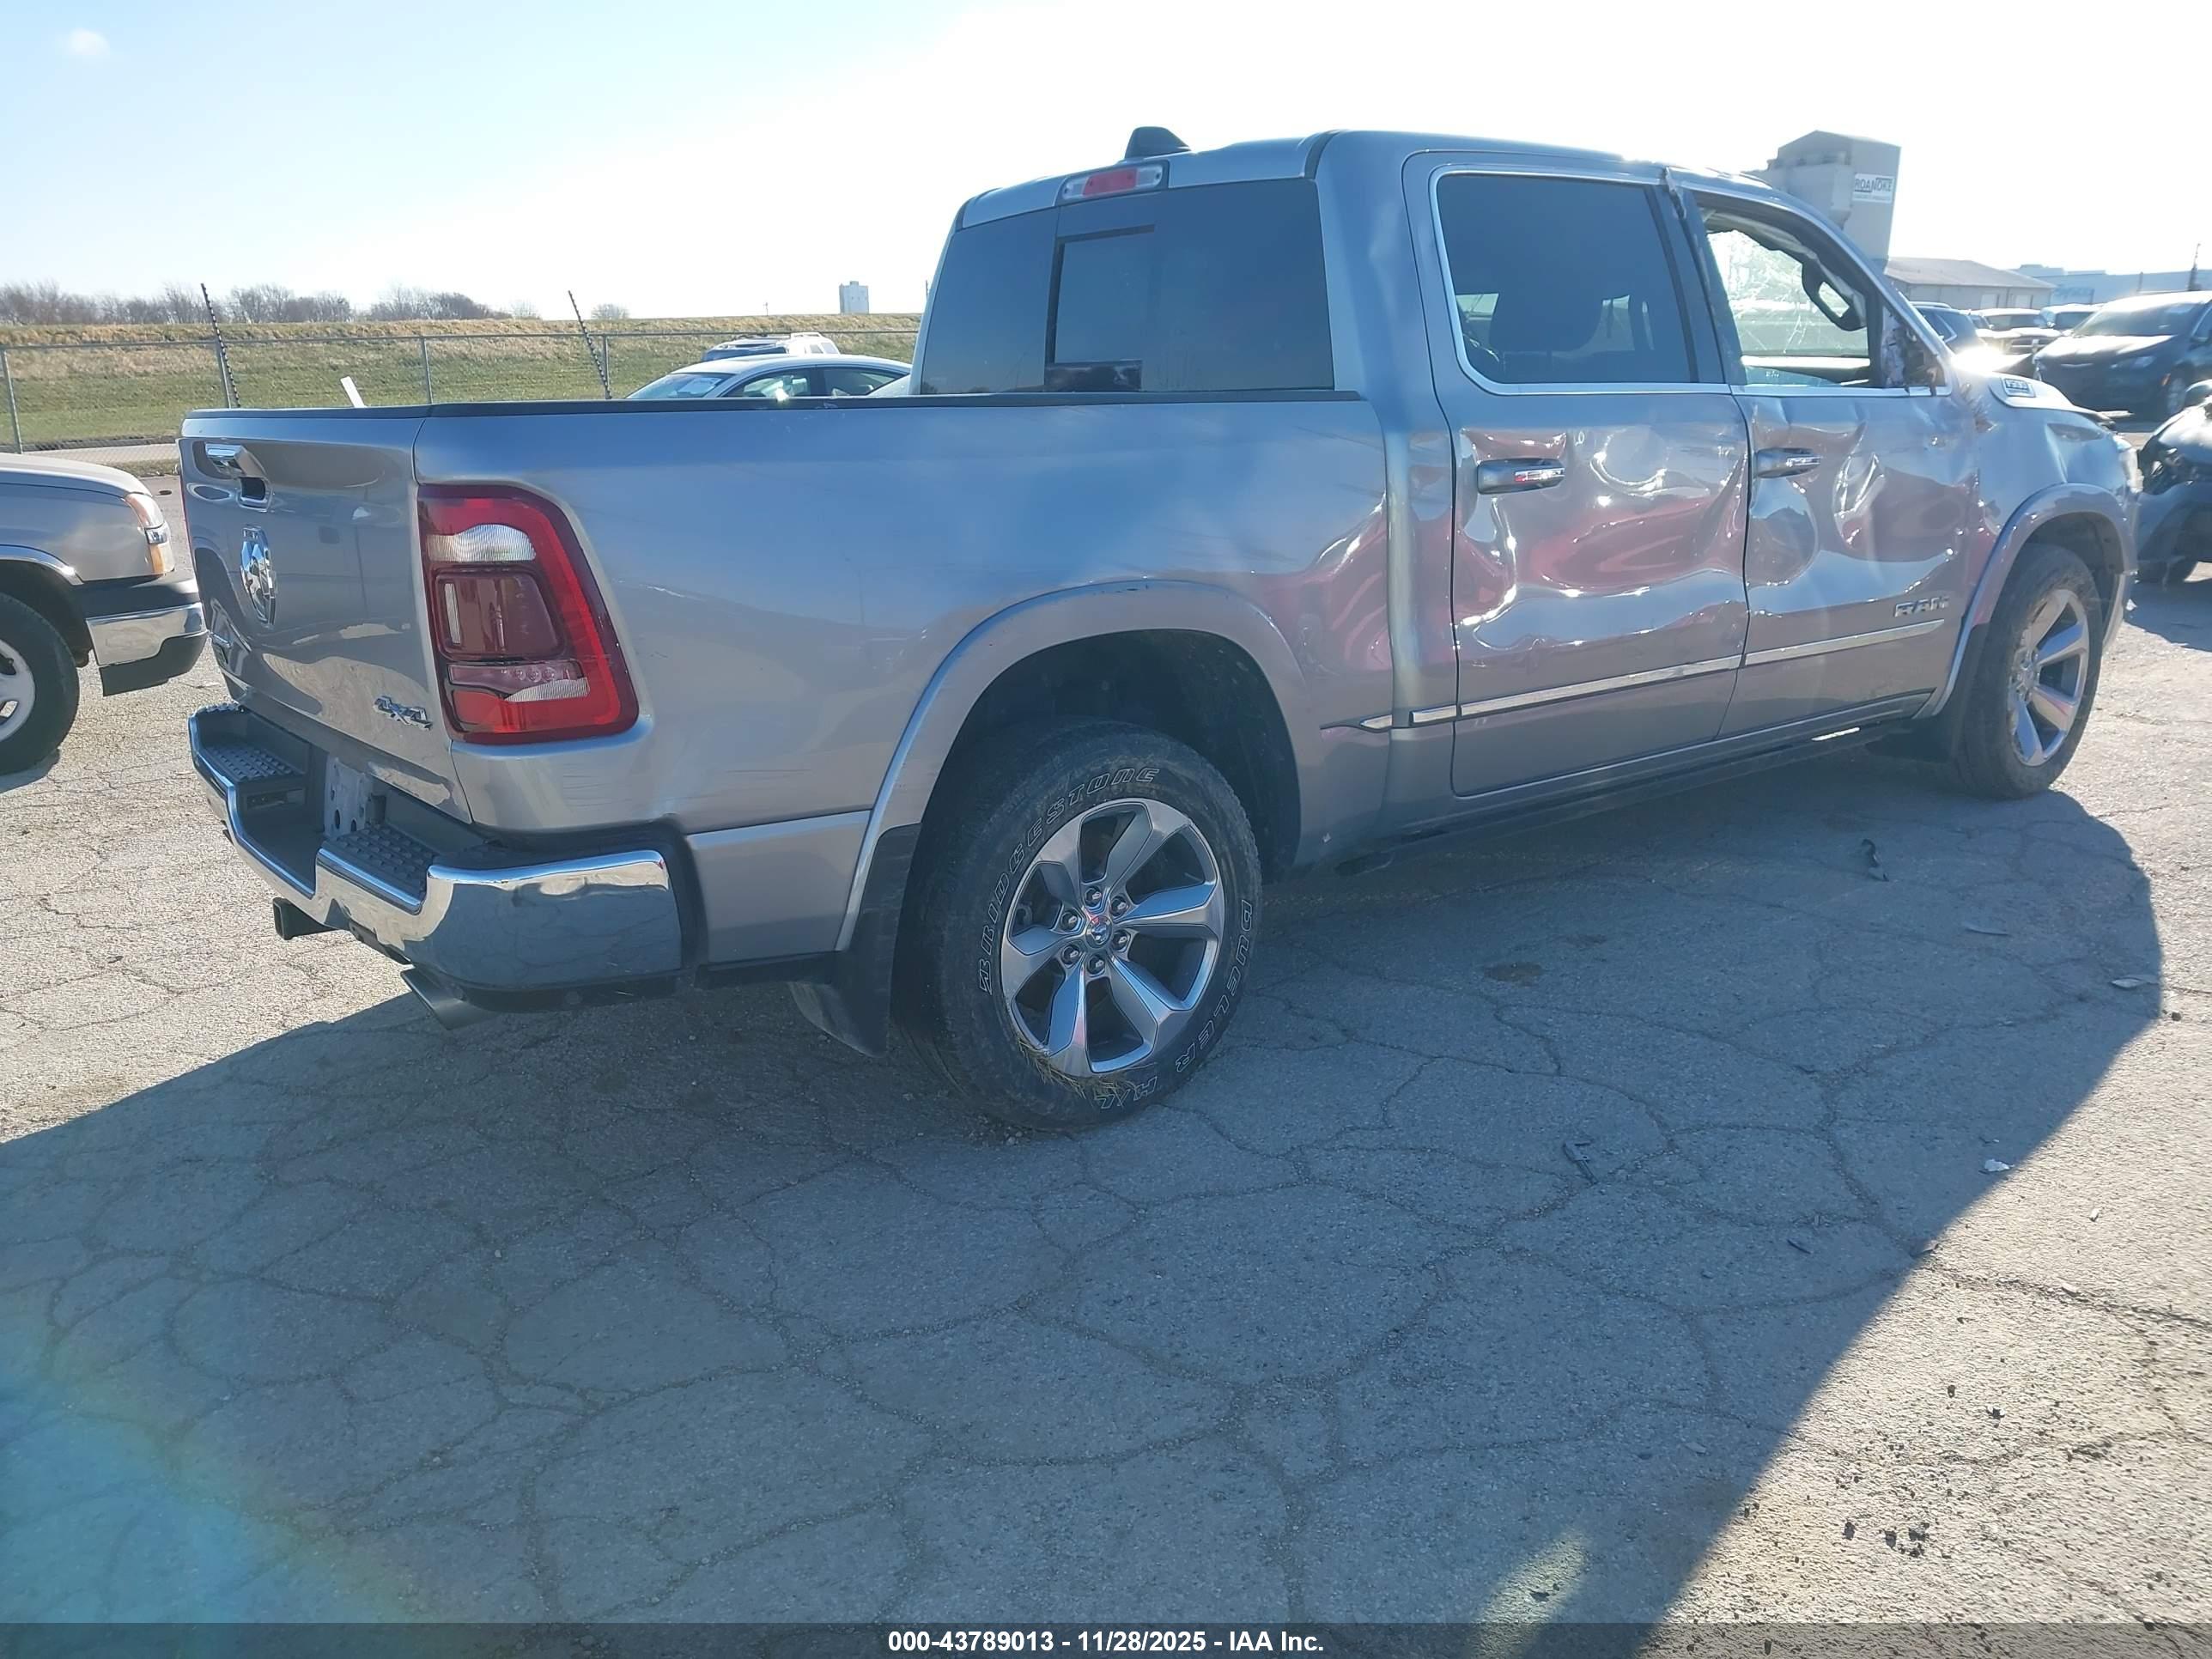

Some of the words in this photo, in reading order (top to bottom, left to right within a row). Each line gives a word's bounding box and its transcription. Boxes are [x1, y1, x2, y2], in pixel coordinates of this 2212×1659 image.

[1893, 596, 1950, 618] RAM
[978, 767, 1160, 996] BRIDGESTONE
[1175, 898, 1253, 1073] DUELER
